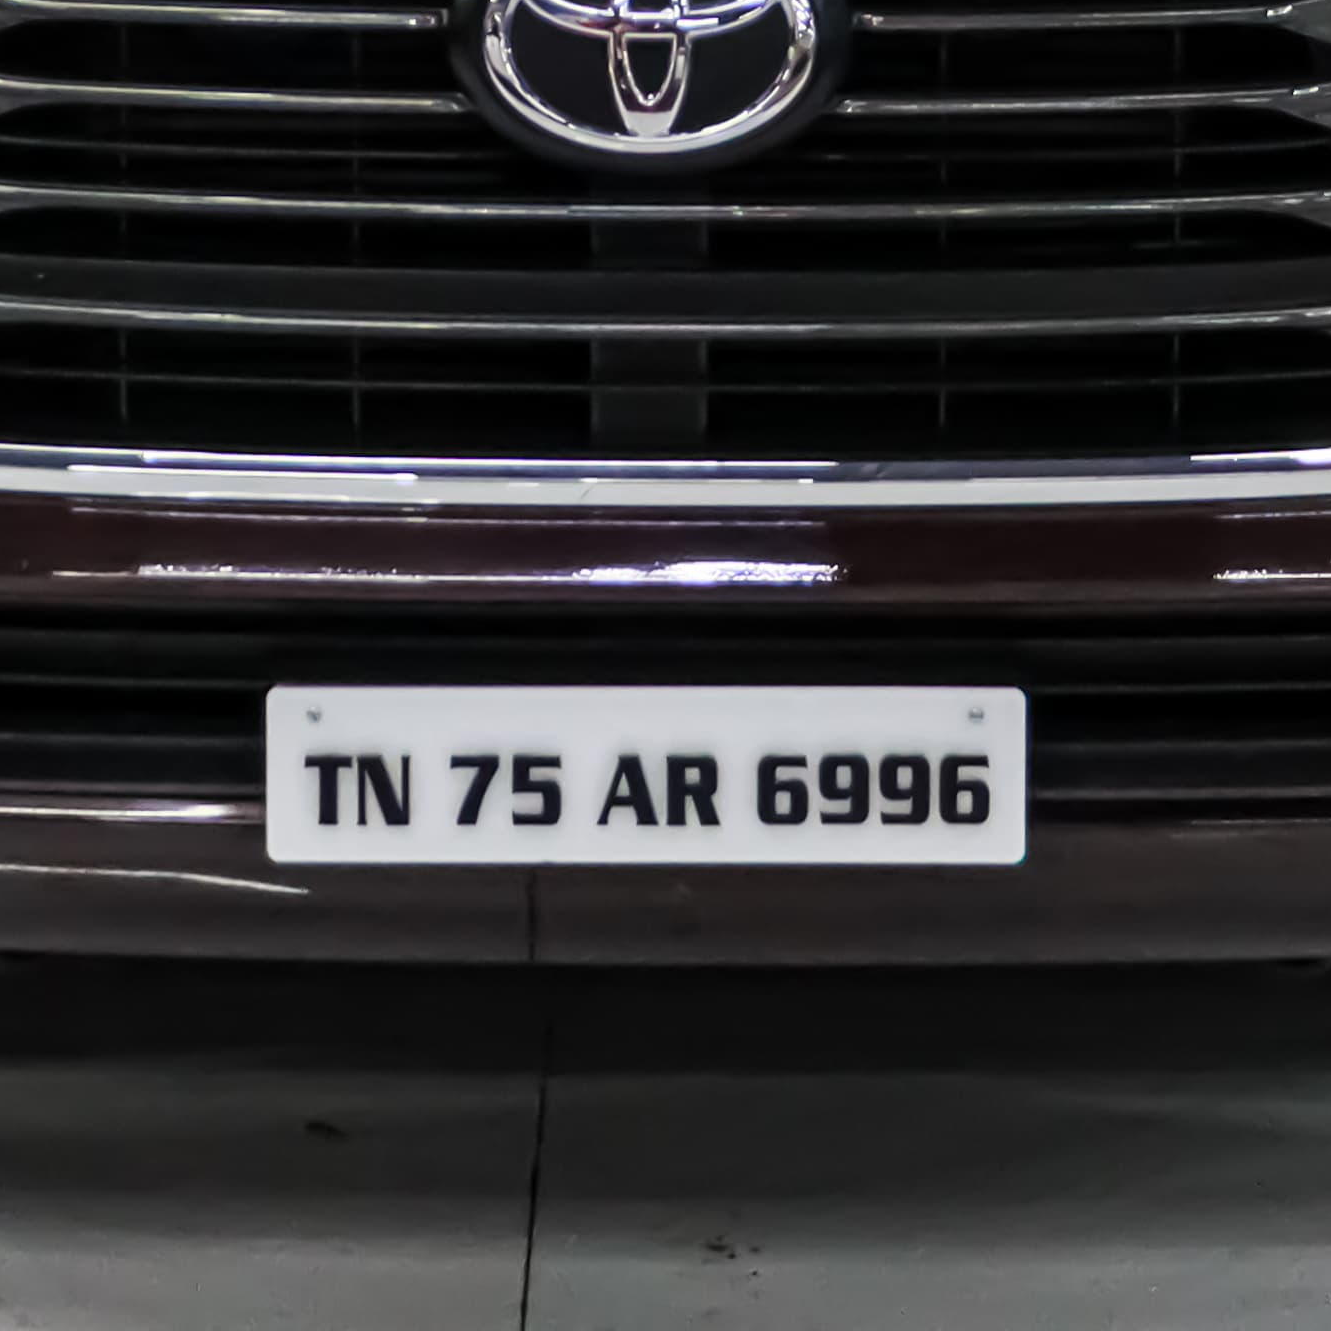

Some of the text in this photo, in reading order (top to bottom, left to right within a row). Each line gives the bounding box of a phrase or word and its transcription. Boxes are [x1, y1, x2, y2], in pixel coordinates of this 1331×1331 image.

[304, 754, 991, 826] TN 75 AR 6996
